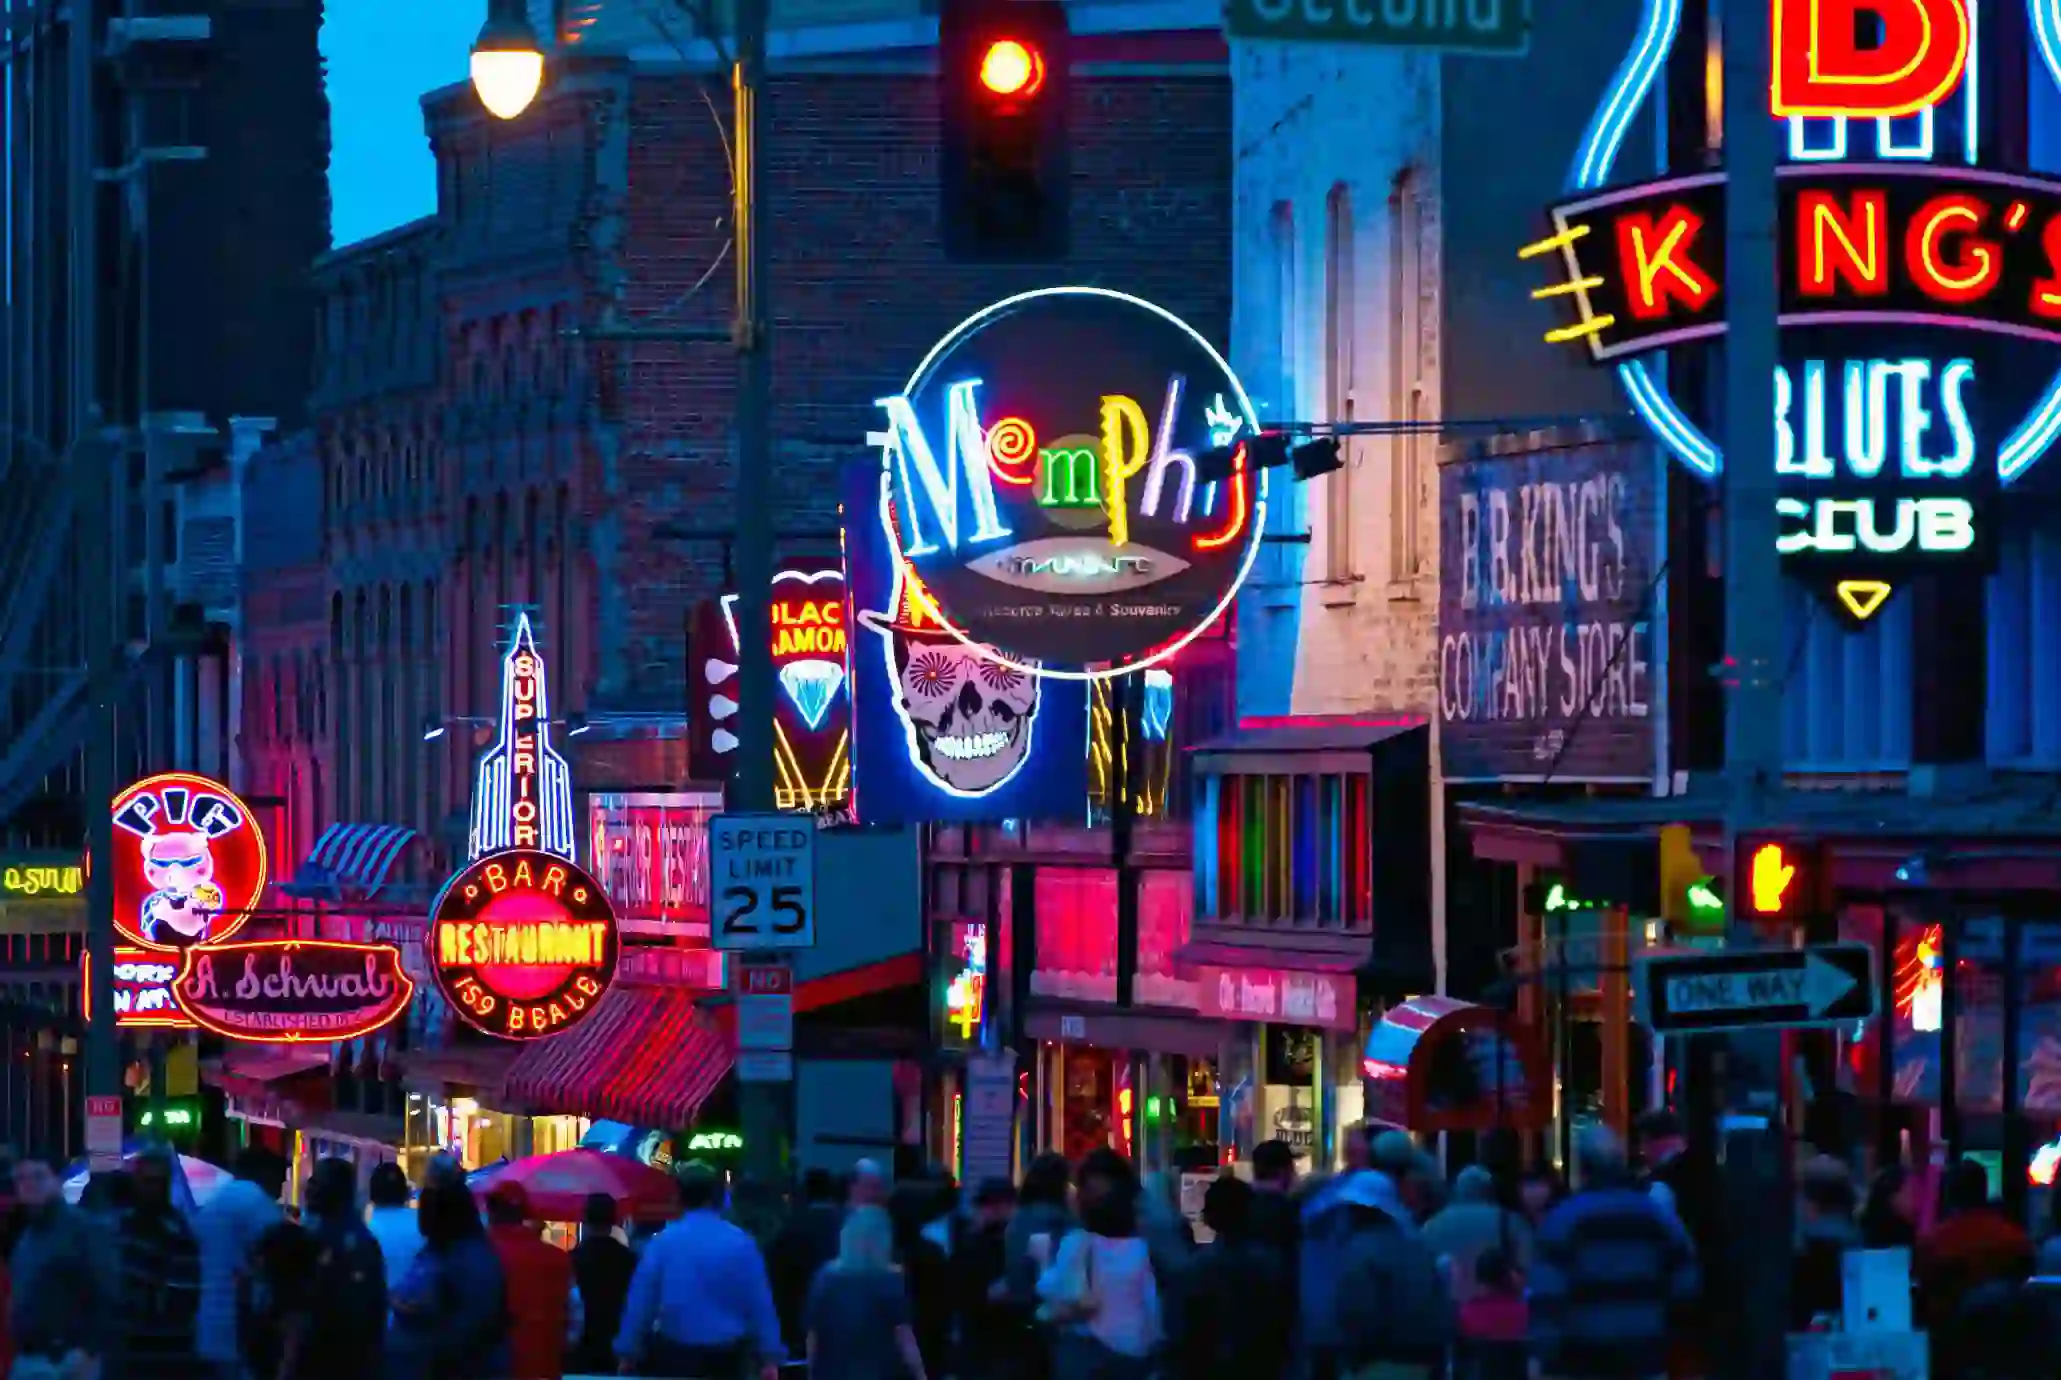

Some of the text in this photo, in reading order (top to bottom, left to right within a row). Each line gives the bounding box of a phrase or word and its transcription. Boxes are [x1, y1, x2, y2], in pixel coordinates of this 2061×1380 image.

[1560, 619, 1649, 718] STORE
[513, 652, 537, 847] SUPERIOR
[112, 787, 244, 838] PIG
[721, 829, 807, 851] SPEED
[485, 860, 567, 896] BAR
[729, 857, 797, 879] LIMIT
[722, 885, 805, 934] 25
[440, 921, 607, 965] RESTAURANT
[454, 975, 600, 1031] 159 BEALE
[1675, 971, 1804, 1011] ONE WAY
